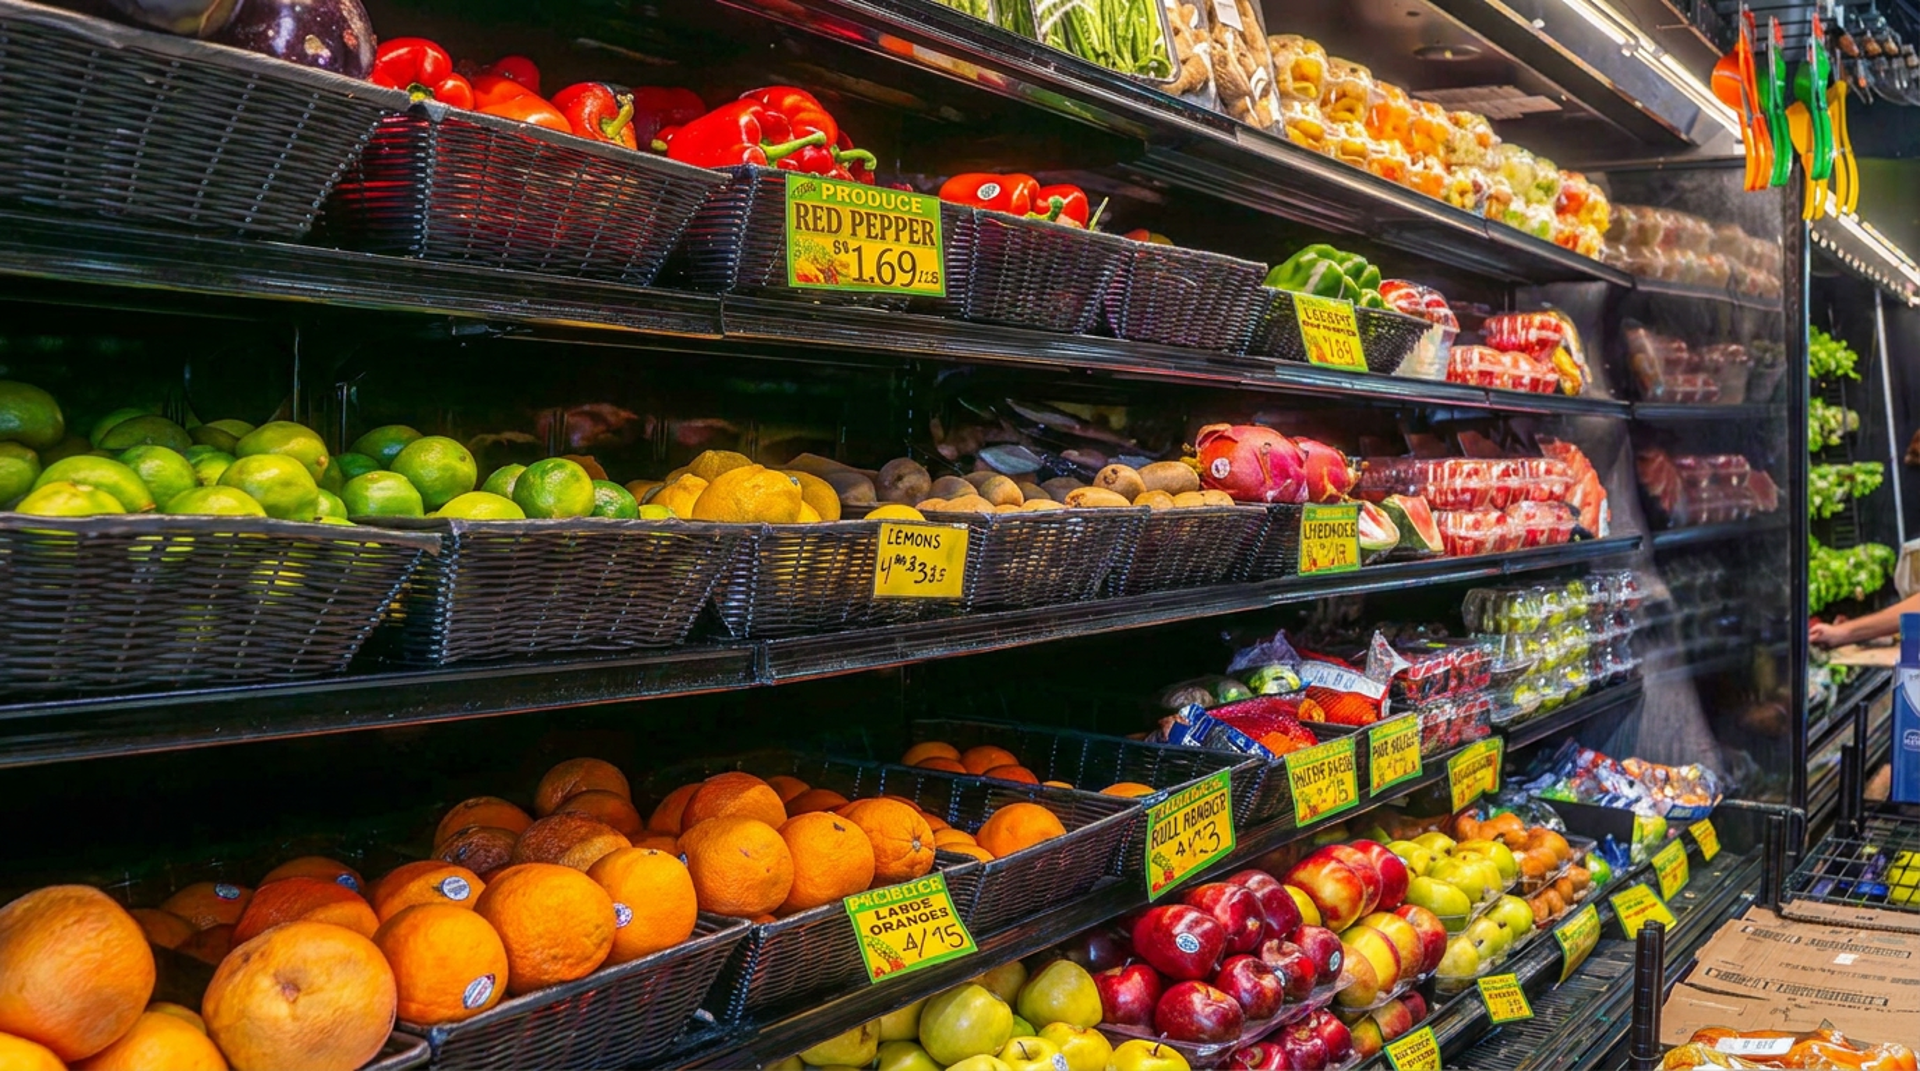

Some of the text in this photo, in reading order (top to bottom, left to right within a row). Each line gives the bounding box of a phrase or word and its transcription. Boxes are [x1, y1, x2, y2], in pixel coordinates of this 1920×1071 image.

[821, 182, 923, 214] PRODUCE
[794, 202, 936, 247] RED PEPPER
[887, 528, 941, 549] LEMONS
